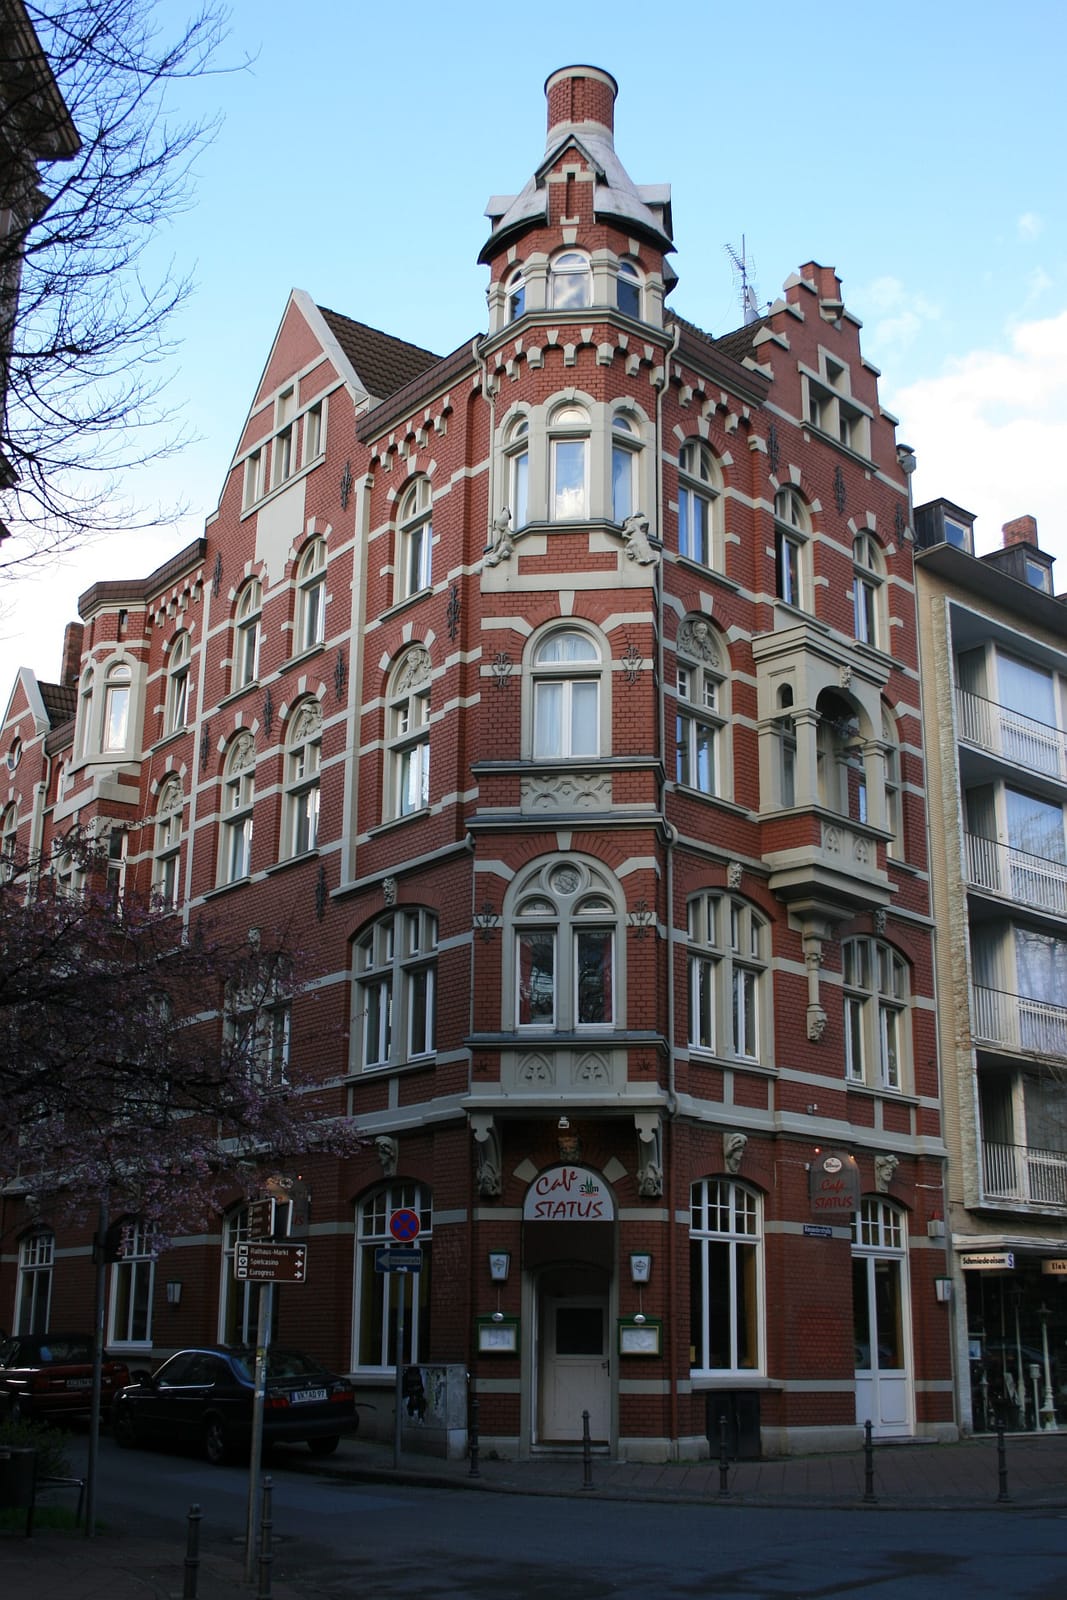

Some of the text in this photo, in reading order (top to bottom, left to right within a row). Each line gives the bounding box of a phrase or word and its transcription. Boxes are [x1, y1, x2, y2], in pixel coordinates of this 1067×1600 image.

[815, 1195, 854, 1209] STATUS
[534, 1200, 604, 1219] STATUS
[249, 1268, 276, 1278] Eurogress
